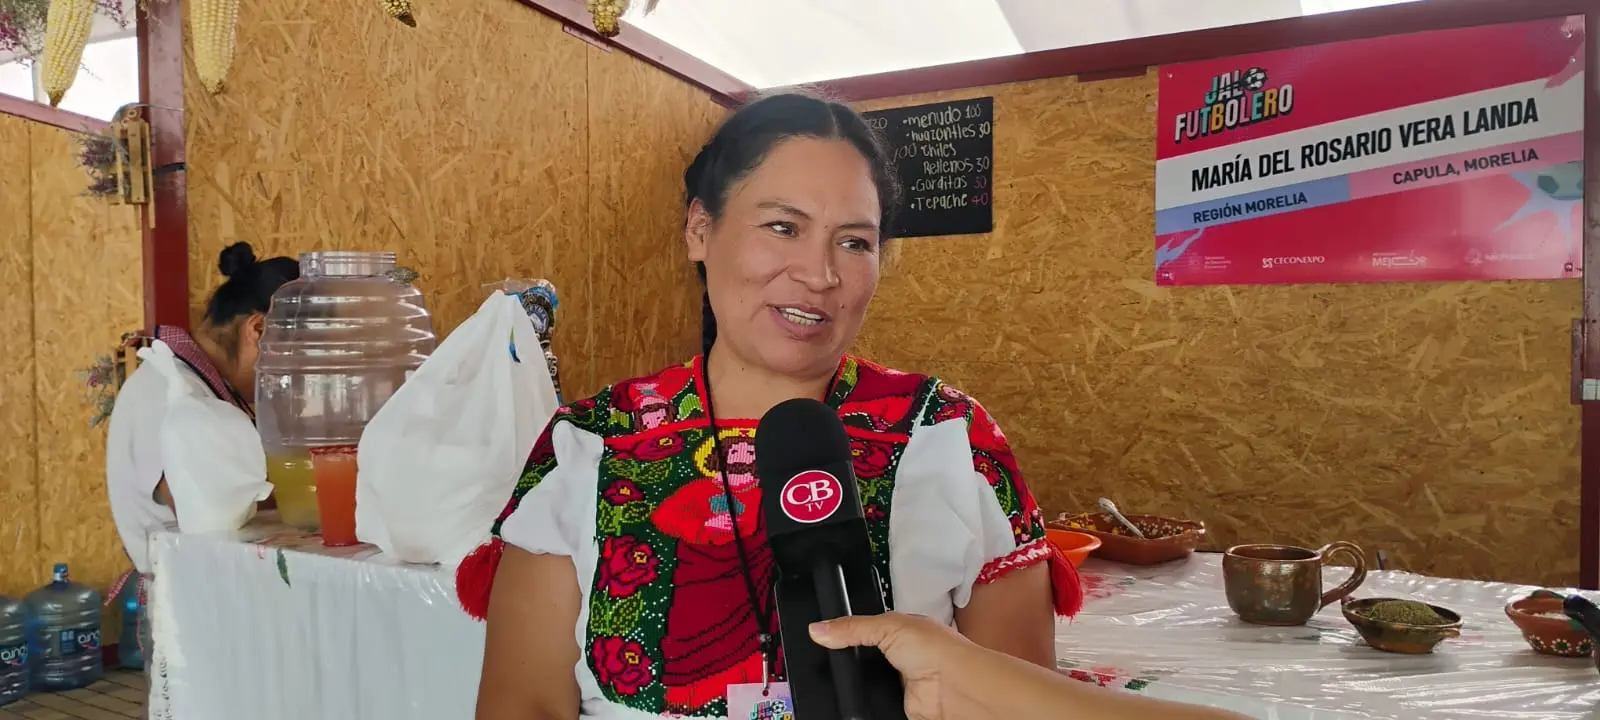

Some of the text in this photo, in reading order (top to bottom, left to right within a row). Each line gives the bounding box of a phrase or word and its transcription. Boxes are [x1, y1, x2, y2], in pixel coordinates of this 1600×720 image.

[907, 104, 982, 128] menudo 100
[1175, 83, 1293, 143] FUTBOLERO
[978, 121, 991, 138] 30
[1191, 97, 1539, 192] MARÍA DEL ROSARIO VERA LANDA
[923, 156, 990, 175] Rellenos 30
[1392, 148, 1540, 185] CAPULA, MORELIA
[915, 175, 968, 192] Gorditas
[914, 192, 988, 211] Tepache 40
[1193, 191, 1309, 224] REGIÓN MORELIA
[1273, 255, 1325, 265] CECONEXPO
[786, 479, 834, 505] CB
[805, 500, 825, 513] TV
